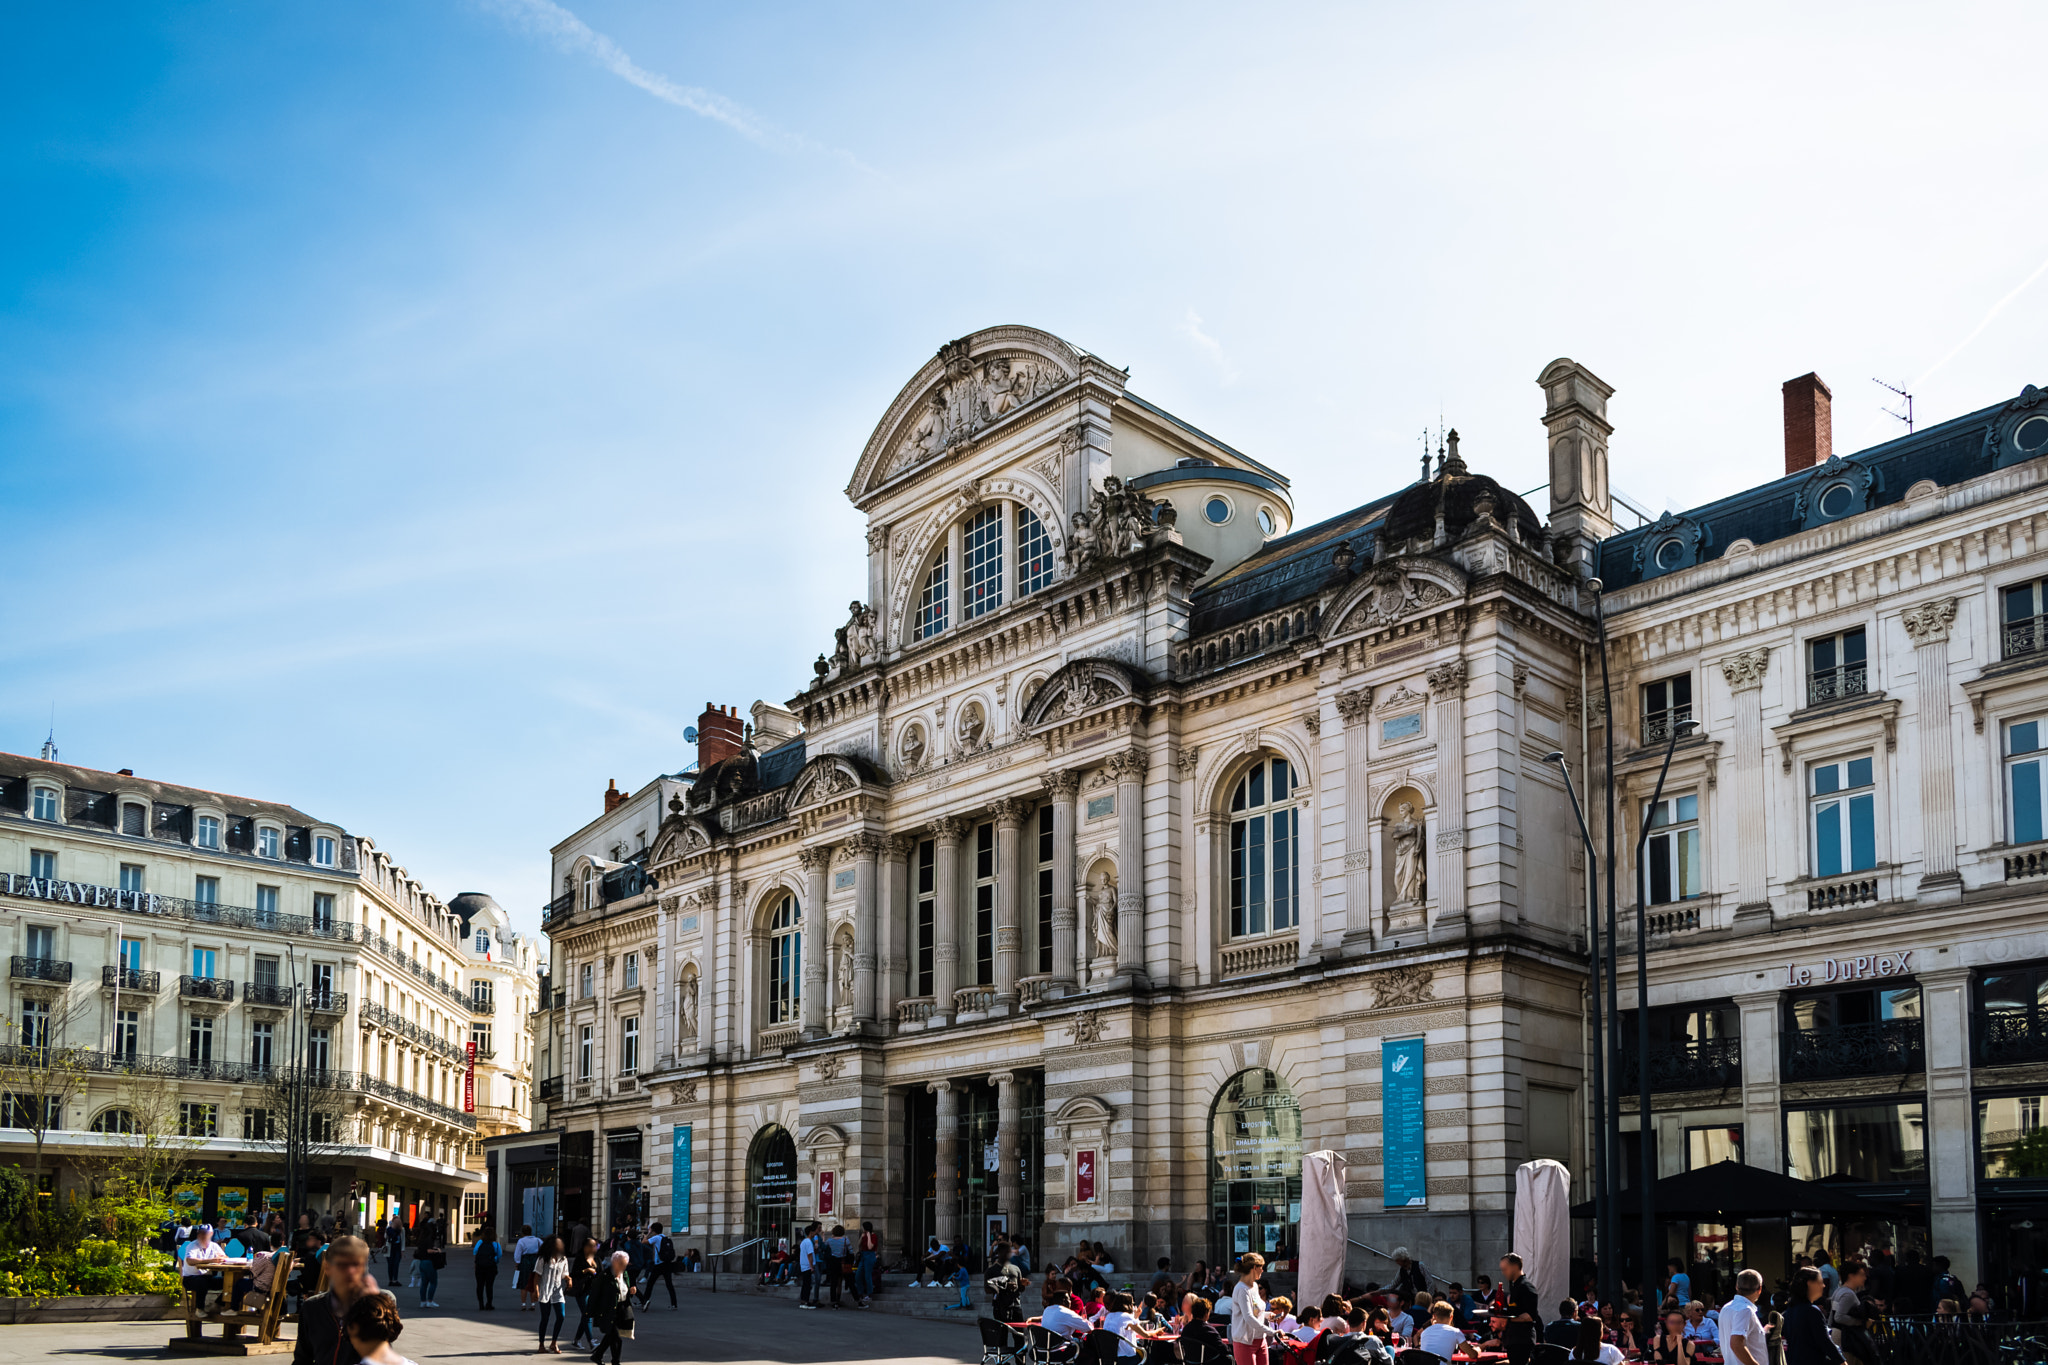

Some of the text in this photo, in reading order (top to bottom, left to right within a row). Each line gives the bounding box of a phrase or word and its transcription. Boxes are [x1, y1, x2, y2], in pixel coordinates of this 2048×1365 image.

[7, 873, 162, 914] LAFAYETTE
[1786, 963, 1810, 987] Le
[1241, 1121, 1272, 1129] EXPOSITION
